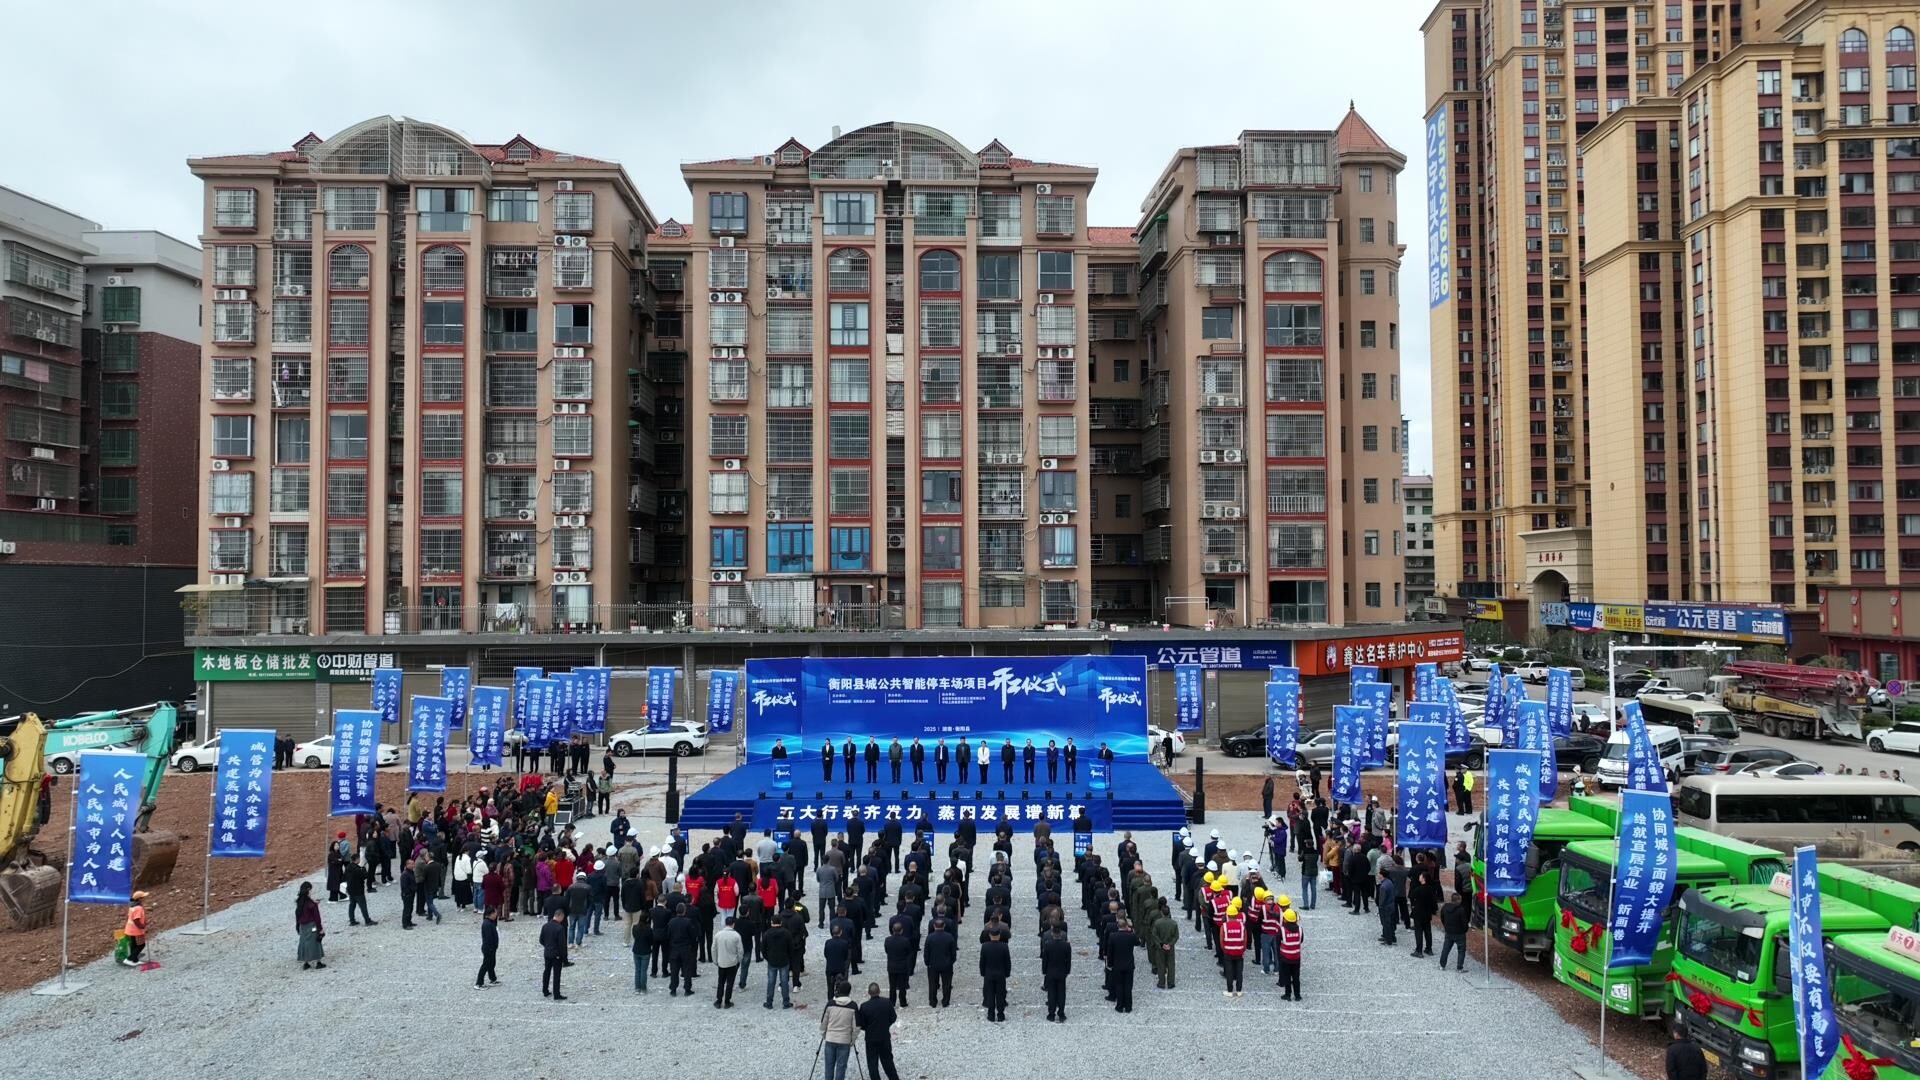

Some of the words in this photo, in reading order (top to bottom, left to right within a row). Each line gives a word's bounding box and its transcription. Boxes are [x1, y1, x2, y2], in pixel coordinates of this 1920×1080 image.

[1677, 609, 1736, 631] 公元管道
[202, 654, 311, 670] 木地板仓储批发
[332, 653, 394, 668] 中财管道
[1157, 647, 1242, 664] 公元管道
[1344, 640, 1424, 666] 鑫达名车养护中心
[752, 690, 796, 716] 开工仪式
[828, 678, 987, 690] 衡阳县城公共智能停车场项目
[987, 667, 1067, 710] 开工仪式
[1098, 687, 1142, 714] 开工仪式
[1285, 691, 1295, 750] 人民城市人民建
[356, 720, 374, 797] 协同城乡面貌大提升
[1424, 736, 1440, 823] 人民城市人民建
[244, 742, 266, 830] 城管为民办实事
[1406, 749, 1421, 835] 人民城市为人民
[107, 768, 133, 871] 人民城市人民建
[777, 804, 924, 820] 五大行动齐发力
[1494, 779, 1512, 879] 共建蒸阳新颜值
[80, 784, 104, 886] 人民城市为人民
[1636, 808, 1669, 934] 协同城乡面貌大提升
